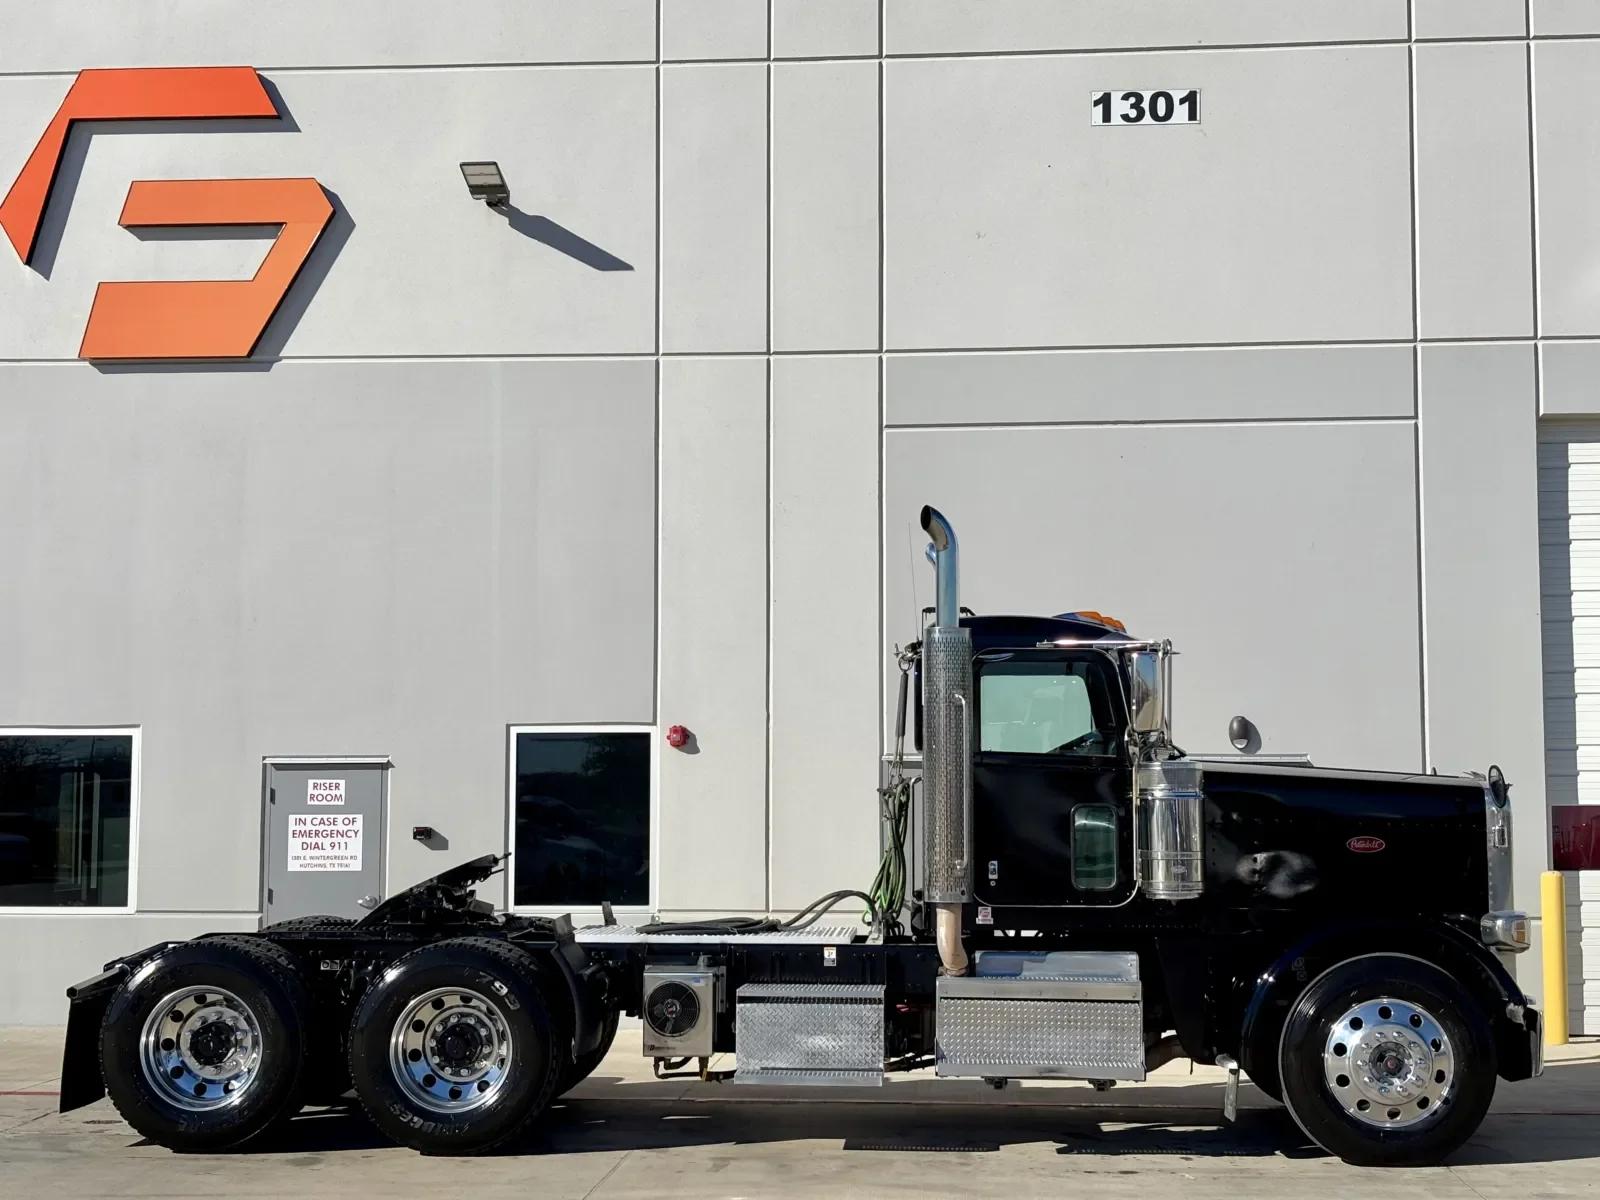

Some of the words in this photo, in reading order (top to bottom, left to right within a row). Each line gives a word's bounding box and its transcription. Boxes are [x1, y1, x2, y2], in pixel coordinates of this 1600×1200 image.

[1093, 90, 1198, 123] 1301
[312, 782, 341, 791] RISER
[309, 793, 343, 802] ROOM
[294, 817, 307, 826] IN
[310, 817, 339, 826] CASE
[342, 816, 357, 826] OF
[292, 829, 360, 838] EMERGENCY
[301, 841, 326, 851] DIAL
[329, 841, 348, 851] 911
